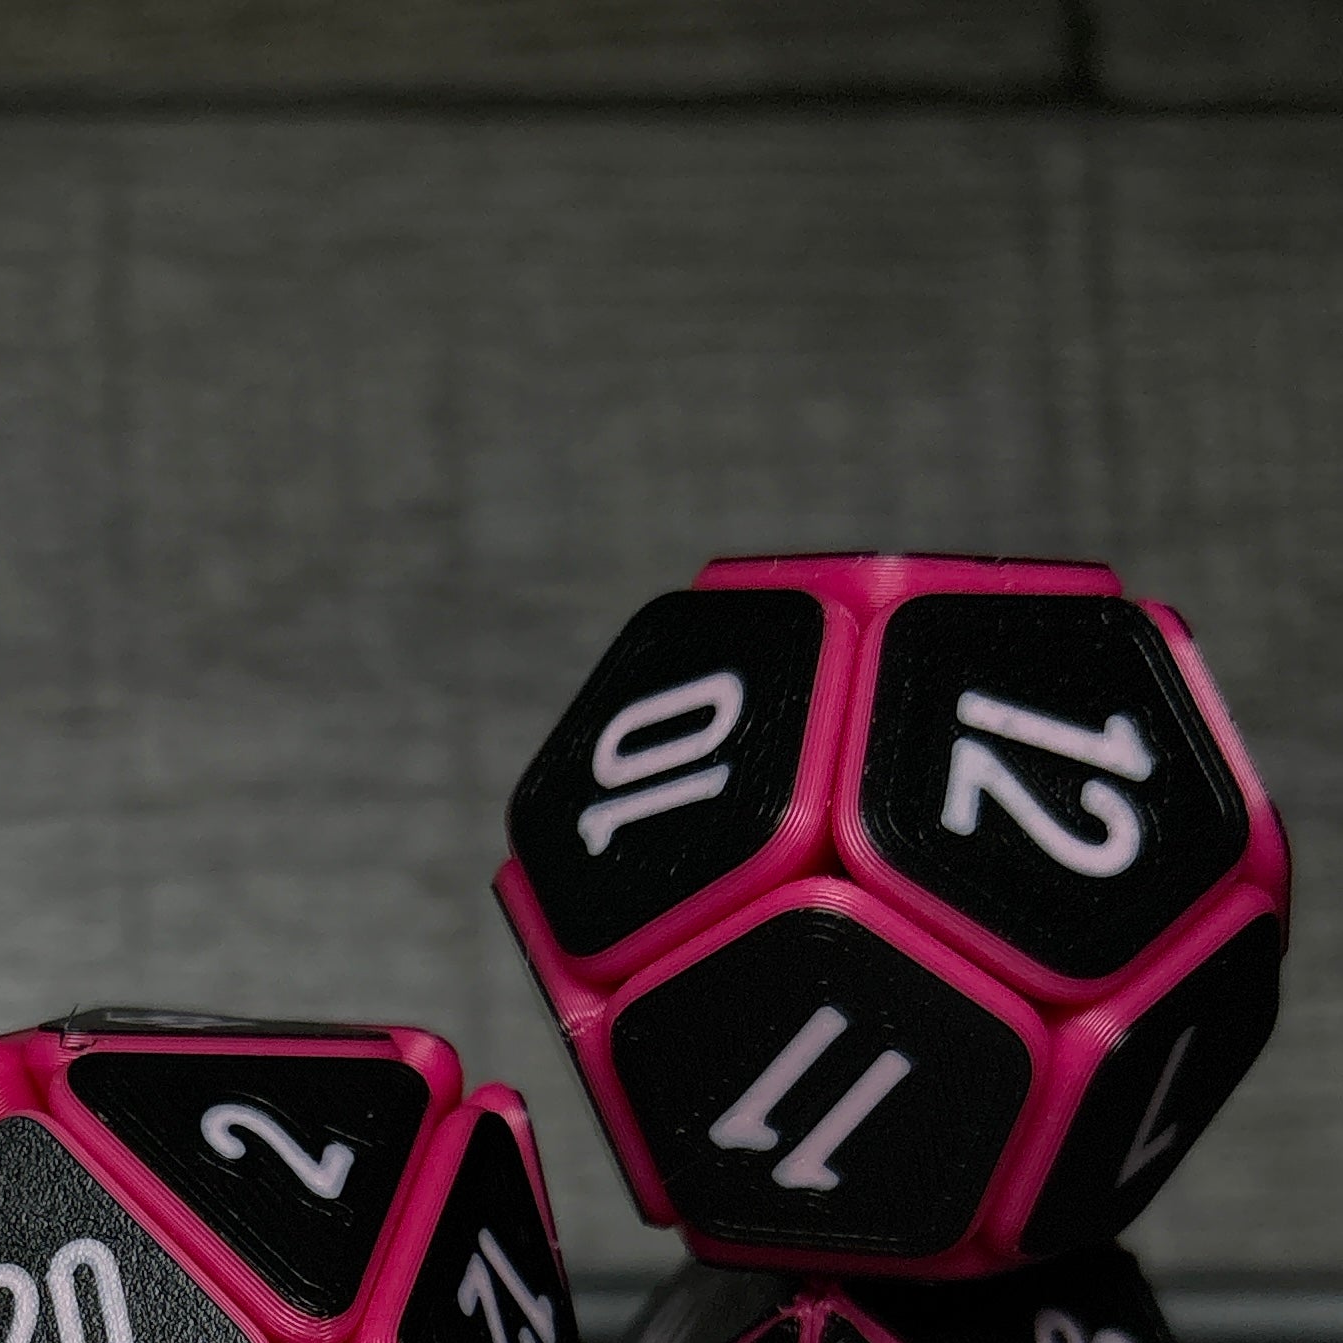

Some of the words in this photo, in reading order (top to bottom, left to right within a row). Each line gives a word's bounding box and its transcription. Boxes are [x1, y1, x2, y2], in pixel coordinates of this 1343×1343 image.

[576, 671, 744, 857] 10
[940, 691, 1156, 878] 12
[200, 1103, 355, 1200] 2
[708, 1005, 912, 1192] 11
